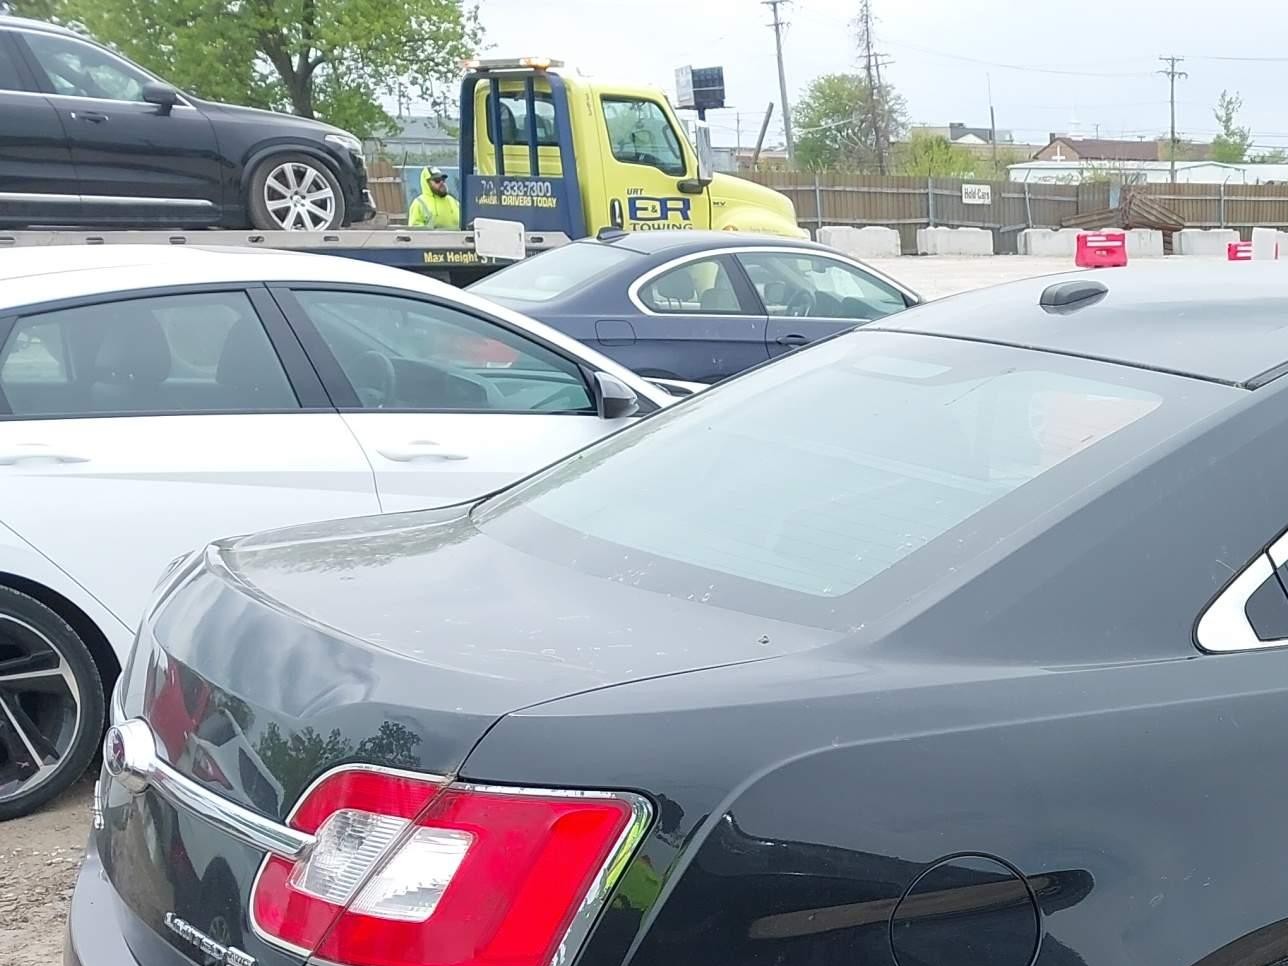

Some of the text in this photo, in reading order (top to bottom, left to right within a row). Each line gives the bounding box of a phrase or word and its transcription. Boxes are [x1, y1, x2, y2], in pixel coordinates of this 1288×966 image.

[501, 195, 532, 207] DRIVERS
[533, 196, 557, 208] TODAY
[629, 222, 694, 231] TOWING
[423, 251, 445, 263] Max
[446, 251, 479, 264] Height
